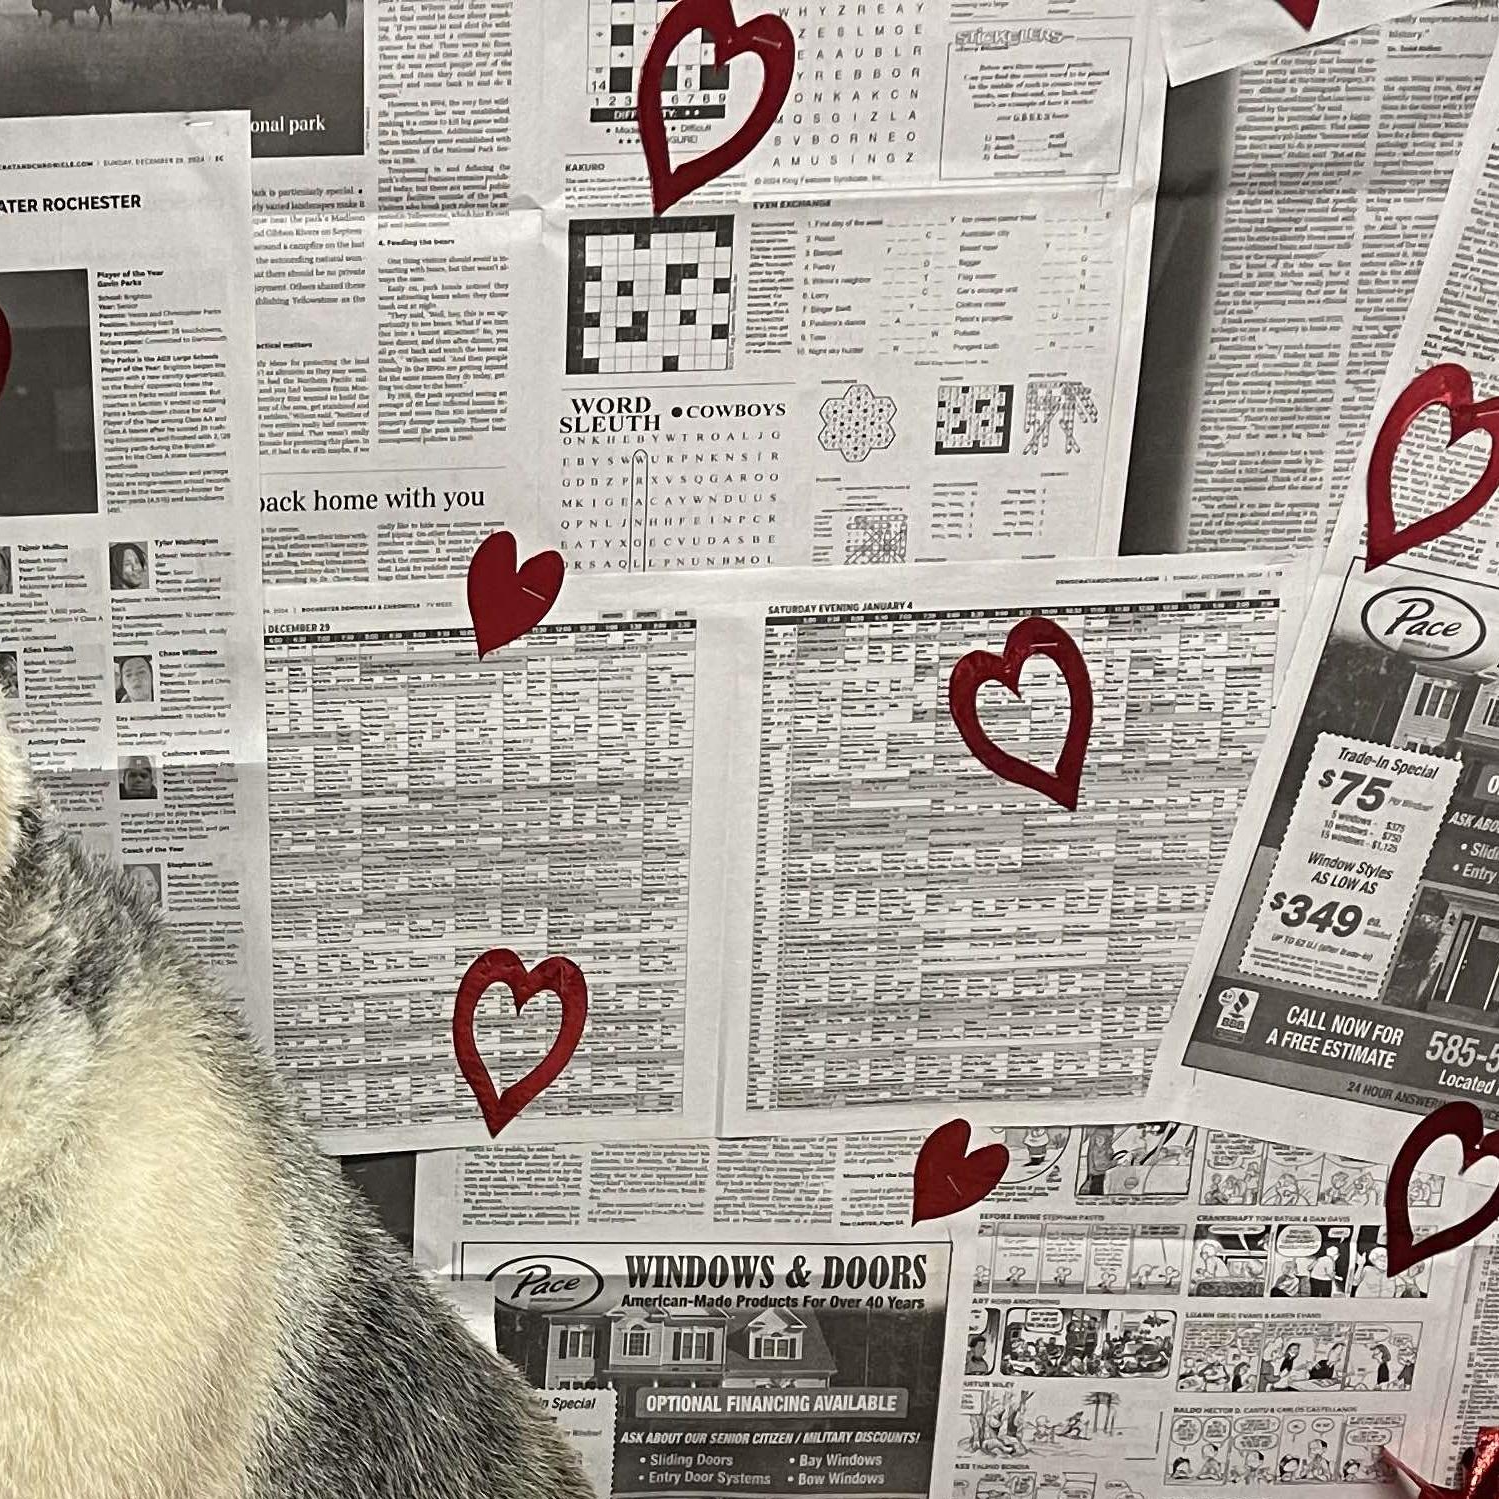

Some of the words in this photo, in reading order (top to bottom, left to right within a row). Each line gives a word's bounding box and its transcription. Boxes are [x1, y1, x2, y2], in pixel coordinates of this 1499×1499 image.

[591, 79, 606, 91] 14
[609, 96, 616, 105] 2
[624, 96, 632, 105] 3
[687, 95, 694, 104] 7
[251, 116, 284, 133] onal
[290, 115, 325, 136] park
[565, 163, 605, 172] KAKURO
[42, 195, 141, 212] ROCHESTER
[571, 397, 652, 414] WORD
[686, 403, 786, 419] COWBOYS
[560, 415, 660, 433] SLEUTH
[315, 489, 378, 510] home
[381, 487, 435, 508] with
[438, 489, 484, 511] you
[768, 604, 815, 615] SATURDAY
[819, 603, 859, 613] EVENING
[862, 602, 905, 612] JANUARY
[1384, 597, 1463, 638] Pace
[268, 624, 317, 633] DECEMBER
[320, 624, 330, 632] 29
[1337, 747, 1390, 770] Trade-In
[1390, 759, 1439, 780] Special
[1318, 768, 1392, 812] $75
[1307, 851, 1354, 873] Window
[1356, 861, 1393, 881] Styles
[1462, 864, 1497, 884] Entry
[1311, 871, 1328, 885] AS
[1329, 874, 1356, 890] LOW
[1361, 881, 1378, 895] AS
[1269, 891, 1364, 938] $349
[1286, 1005, 1328, 1031] CALL
[1331, 1015, 1371, 1039] NOW
[1373, 1024, 1404, 1046] FOR
[1266, 1031, 1278, 1045] A
[1281, 1034, 1319, 1054] FREE
[1322, 1040, 1397, 1069] ESTIMATE
[1438, 1069, 1492, 1095] Located
[625, 1255, 774, 1289] WINDOWS
[786, 1255, 811, 1289] &
[822, 1254, 927, 1290] DOORS
[511, 1264, 580, 1300] Pace
[621, 1295, 732, 1309] American-Made
[736, 1295, 798, 1309] Products
[803, 1296, 827, 1308] For
[830, 1296, 861, 1308] Over
[866, 1296, 883, 1308] 40
[887, 1296, 924, 1309] Years
[552, 1397, 595, 1412] Special
[646, 1396, 721, 1412] OPTIONAL
[726, 1395, 809, 1411] FINANCING
[813, 1395, 897, 1411] AVAILABLE
[621, 1433, 644, 1443] ASK
[646, 1432, 682, 1443] ABOUT
[685, 1433, 708, 1443] OUR
[710, 1432, 750, 1444] SENIOR
[753, 1432, 793, 1443] CITIZEN
[803, 1432, 852, 1443] MILITARY
[855, 1432, 920, 1443] DISCOUNTS!
[650, 1454, 693, 1467] Sliding
[697, 1455, 733, 1466] Doors
[800, 1454, 824, 1467] Bay
[826, 1454, 883, 1466] Windows
[649, 1472, 682, 1486] Entry
[685, 1471, 714, 1484] Door
[717, 1472, 771, 1486] Systems
[798, 1473, 825, 1485] Bow
[828, 1472, 884, 1485] Windows
